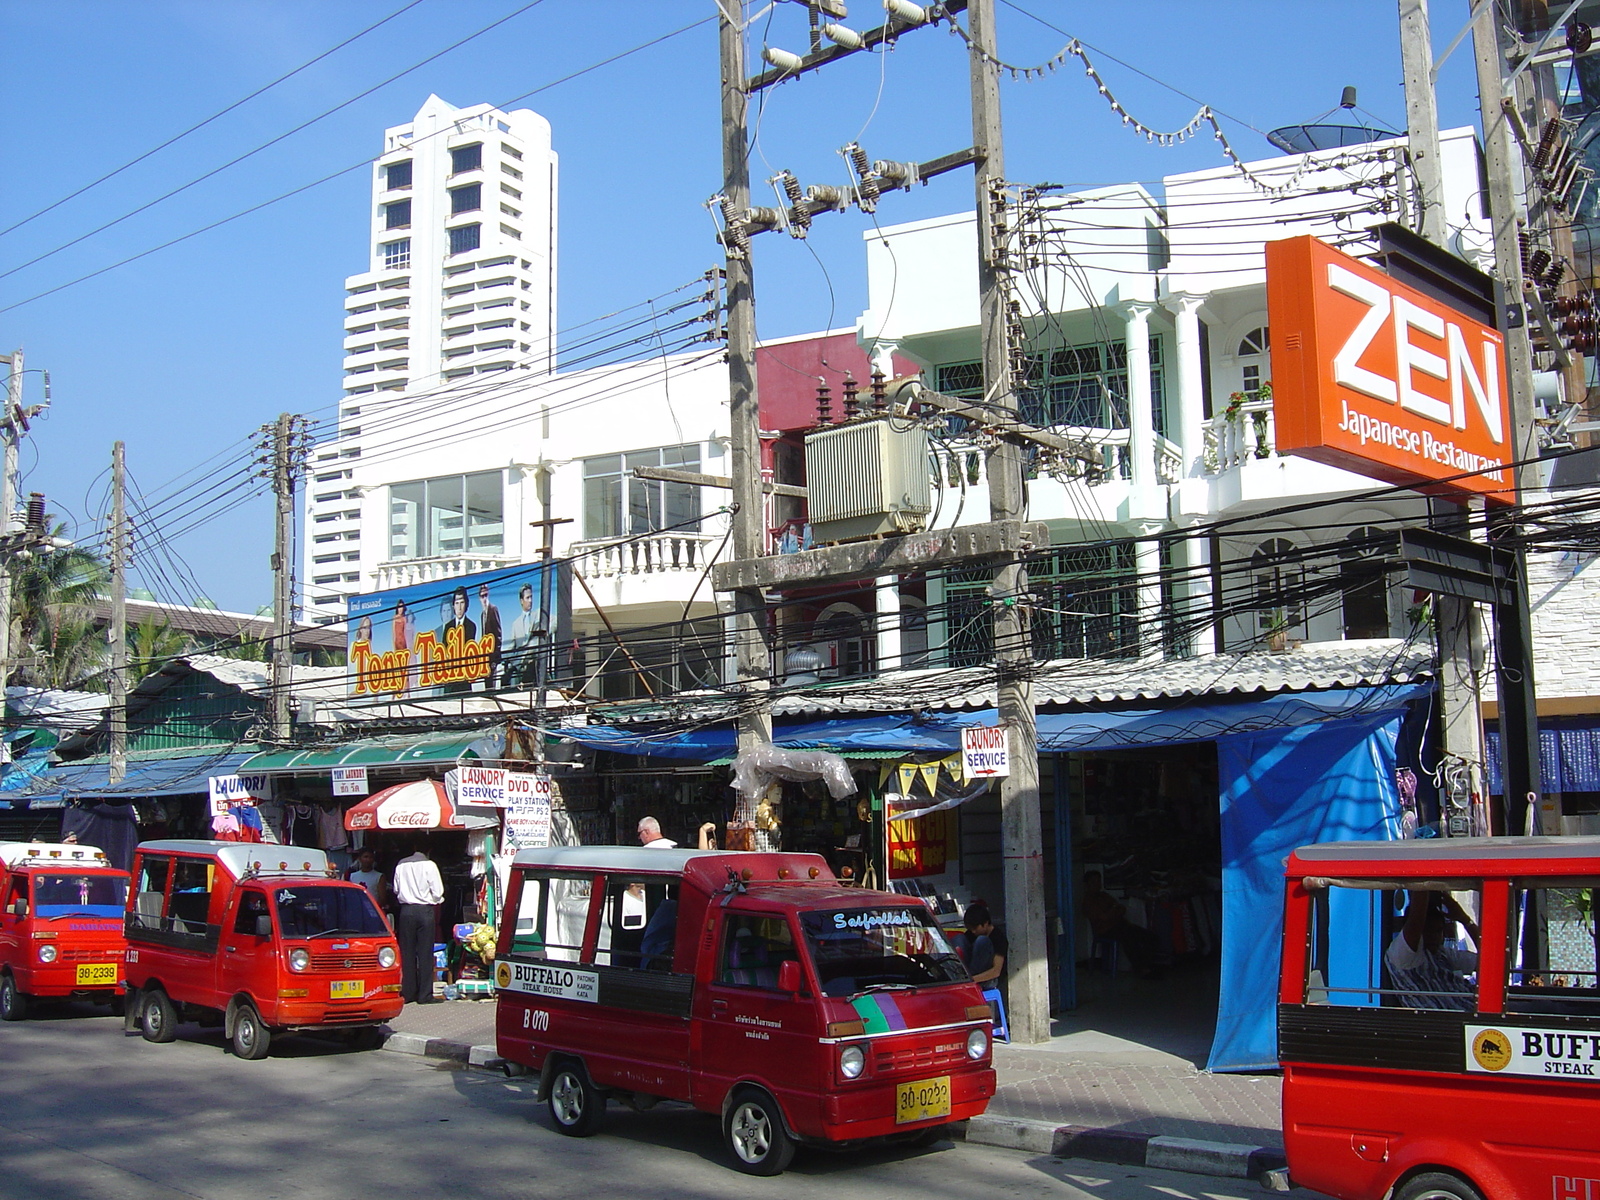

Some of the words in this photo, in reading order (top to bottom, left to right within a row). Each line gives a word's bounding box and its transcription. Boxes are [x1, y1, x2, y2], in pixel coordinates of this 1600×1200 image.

[1327, 263, 1503, 445] ZEN
[1338, 400, 1420, 455] Japanese
[1421, 430, 1504, 483] Restaurant
[351, 640, 411, 698] Tony
[414, 625, 496, 687] Tailor
[966, 729, 1005, 749] LAUNDRY
[967, 752, 1006, 766] SERVICE
[215, 775, 266, 794] LAUNDRY
[462, 768, 505, 786] LAUNDRY
[462, 787, 504, 799] SERVICE
[536, 781, 550, 793] CD
[508, 797, 523, 805] PLAY
[525, 797, 550, 806] STATION
[545, 807, 549, 815] 2
[388, 812, 430, 826] Coca-Cola
[515, 965, 573, 987] BUFFALO
[576, 975, 595, 983] PATONG
[522, 983, 541, 992] STEAK
[543, 986, 563, 995] HOUSE
[523, 1008, 531, 1028] B
[532, 1010, 549, 1032] 070
[1544, 1061, 1595, 1076] STEAK
